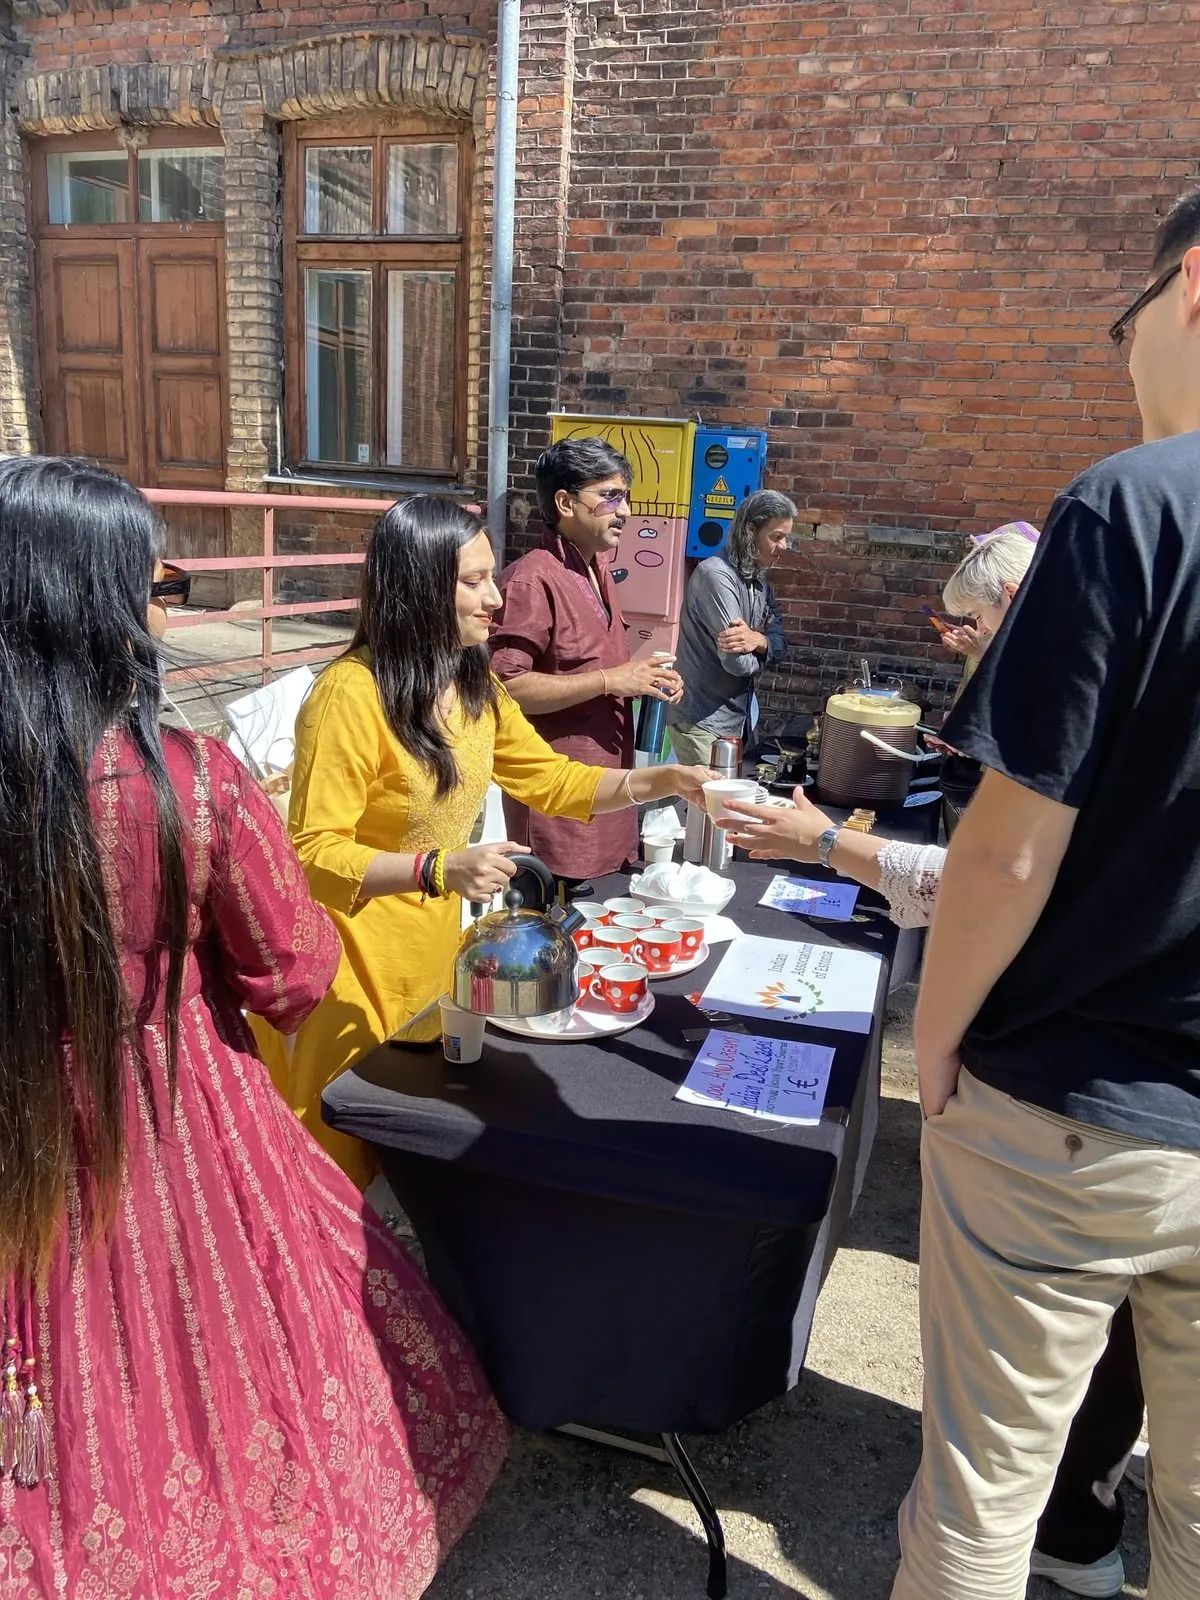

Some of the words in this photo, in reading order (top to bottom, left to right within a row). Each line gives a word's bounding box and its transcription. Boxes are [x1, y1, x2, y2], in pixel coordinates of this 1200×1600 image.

[768, 953, 789, 973] Indian
[791, 943, 814, 976] Association
[816, 950, 834, 972] Estonia
[812, 969, 826, 979] of
[707, 1036, 740, 1062] CREAMY
[702, 1062, 733, 1081] AND
[732, 1062, 769, 1085] Desi
[726, 1084, 763, 1113] Indian
[783, 1077, 819, 1101] 1€
